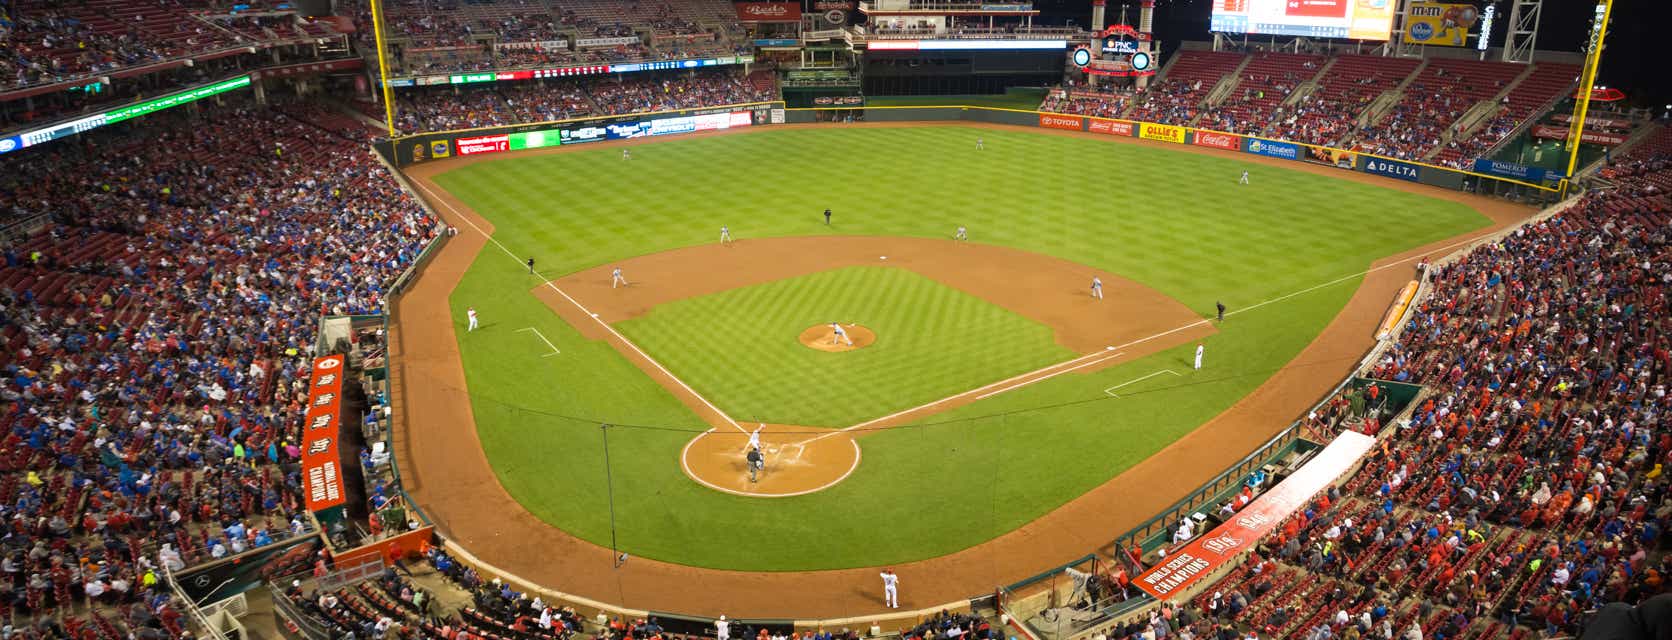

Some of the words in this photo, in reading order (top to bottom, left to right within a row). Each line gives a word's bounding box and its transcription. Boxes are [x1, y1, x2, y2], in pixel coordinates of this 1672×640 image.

[1115, 41, 1132, 49] PNC
[1053, 118, 1080, 127] TOYOTA
[1379, 162, 1417, 178] DELTA
[1491, 162, 1528, 172] POMEROY
[324, 461, 336, 483] NATIONAL
[309, 466, 327, 502] CHAMPIONS
[1205, 536, 1236, 553] 1919
[1144, 564, 1171, 584] WORLD
[1170, 552, 1194, 571] SERIES
[1153, 557, 1210, 594] CHAMPIONS
